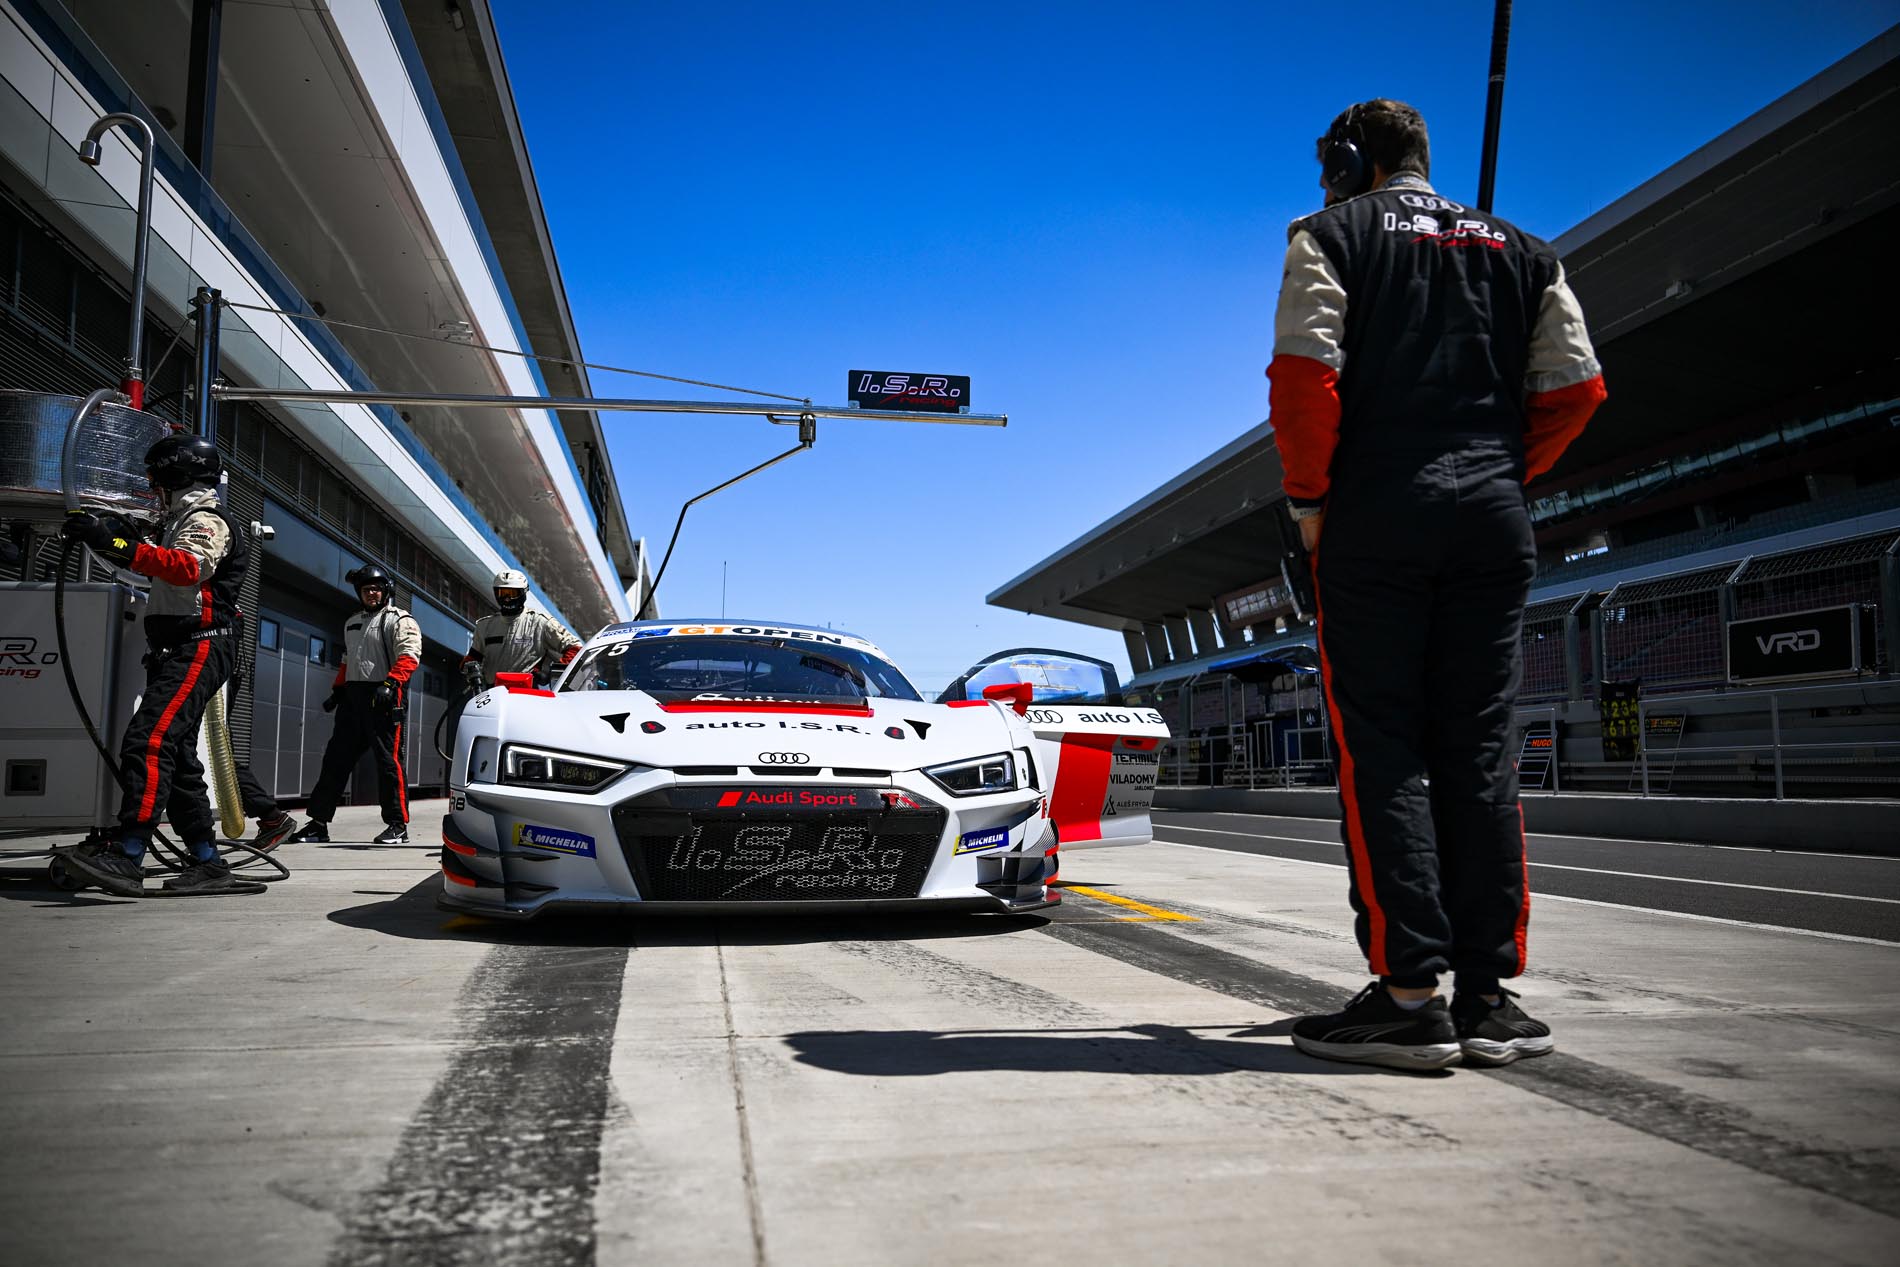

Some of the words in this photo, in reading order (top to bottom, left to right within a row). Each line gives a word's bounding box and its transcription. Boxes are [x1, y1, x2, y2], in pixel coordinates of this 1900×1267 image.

[858, 374, 960, 397] I.S.R.
[899, 397, 957, 407] racing
[1755, 628, 1821, 656] VRD
[585, 640, 633, 663] 75
[1078, 712, 1131, 724] auto
[685, 721, 766, 730] auto
[779, 721, 872, 735] I.S.R.
[1109, 774, 1155, 785] VILADOMY
[745, 791, 794, 805] Audi
[799, 791, 857, 808] Sport
[534, 833, 590, 850] MICHELIN
[967, 833, 1005, 847] MICHELIN
